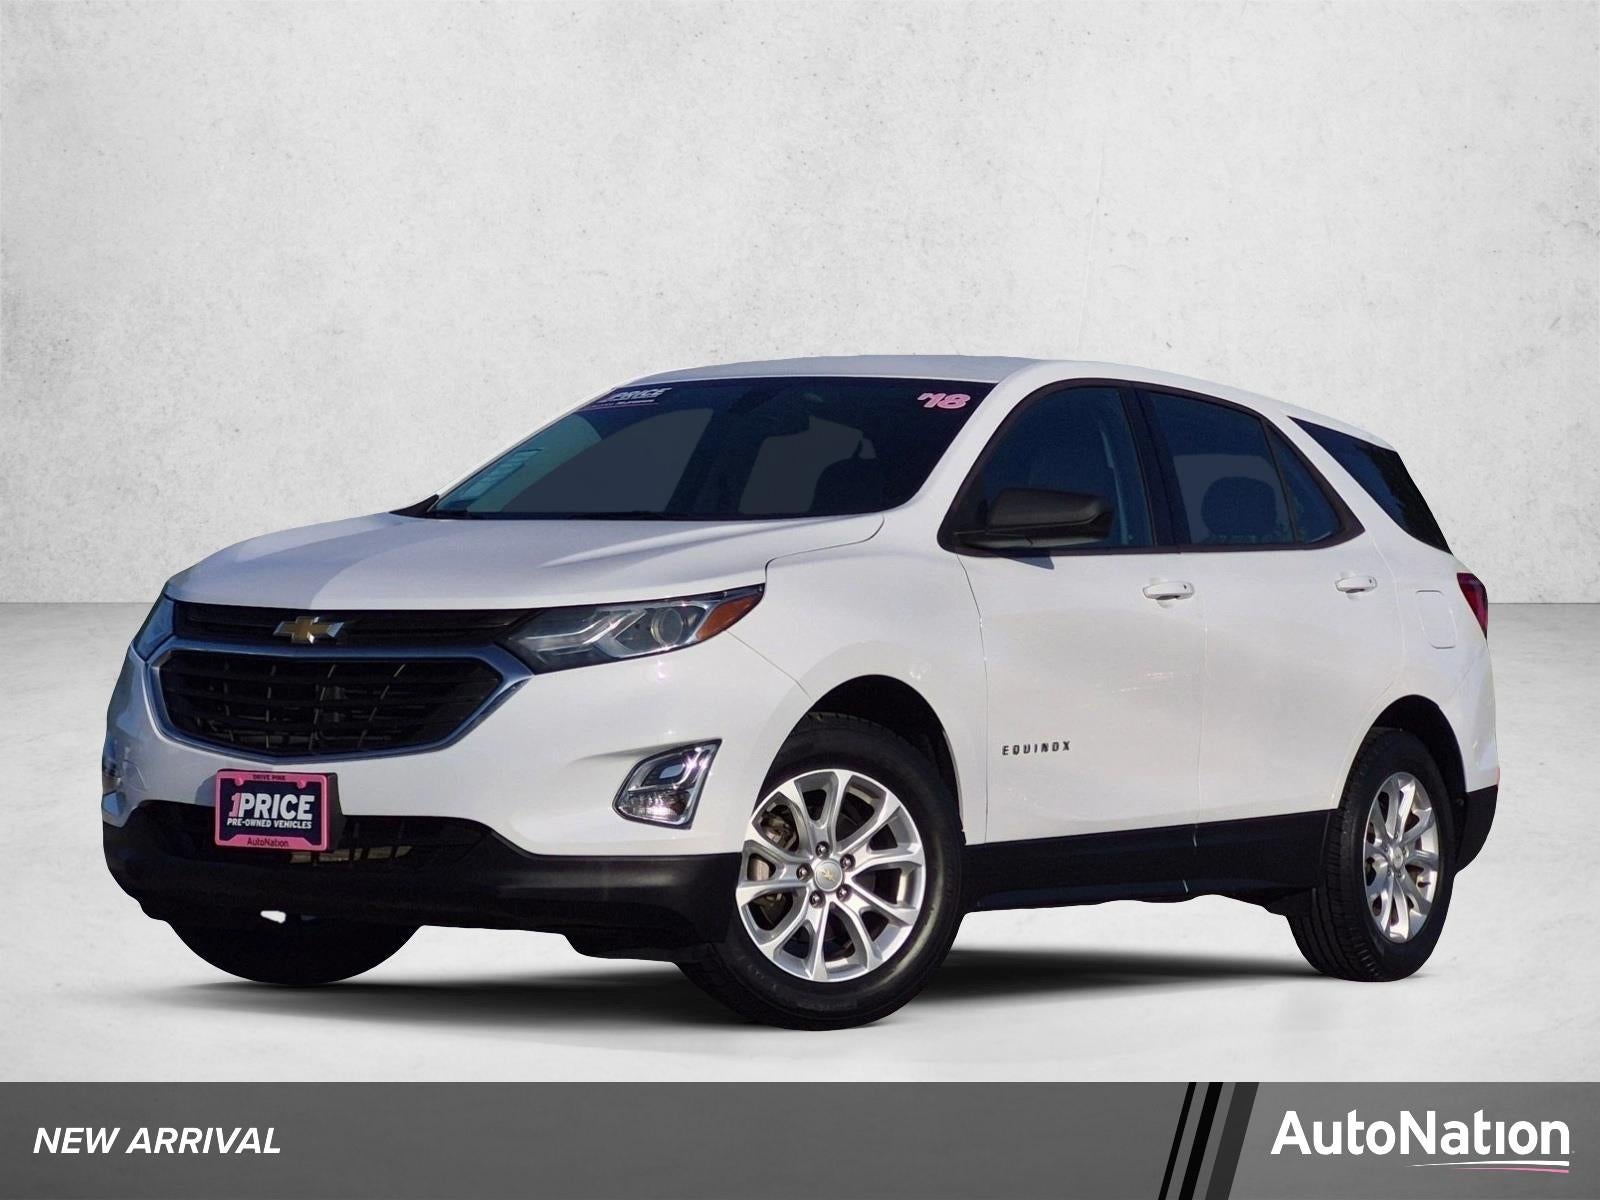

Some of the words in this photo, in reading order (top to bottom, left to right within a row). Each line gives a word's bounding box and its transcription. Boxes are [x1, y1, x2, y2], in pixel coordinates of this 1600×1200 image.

[1002, 741, 1070, 756] EQUINOX
[227, 818, 272, 828] PRE-OWNED
[274, 819, 312, 829] VEHICLES
[246, 837, 289, 847] AutoNation
